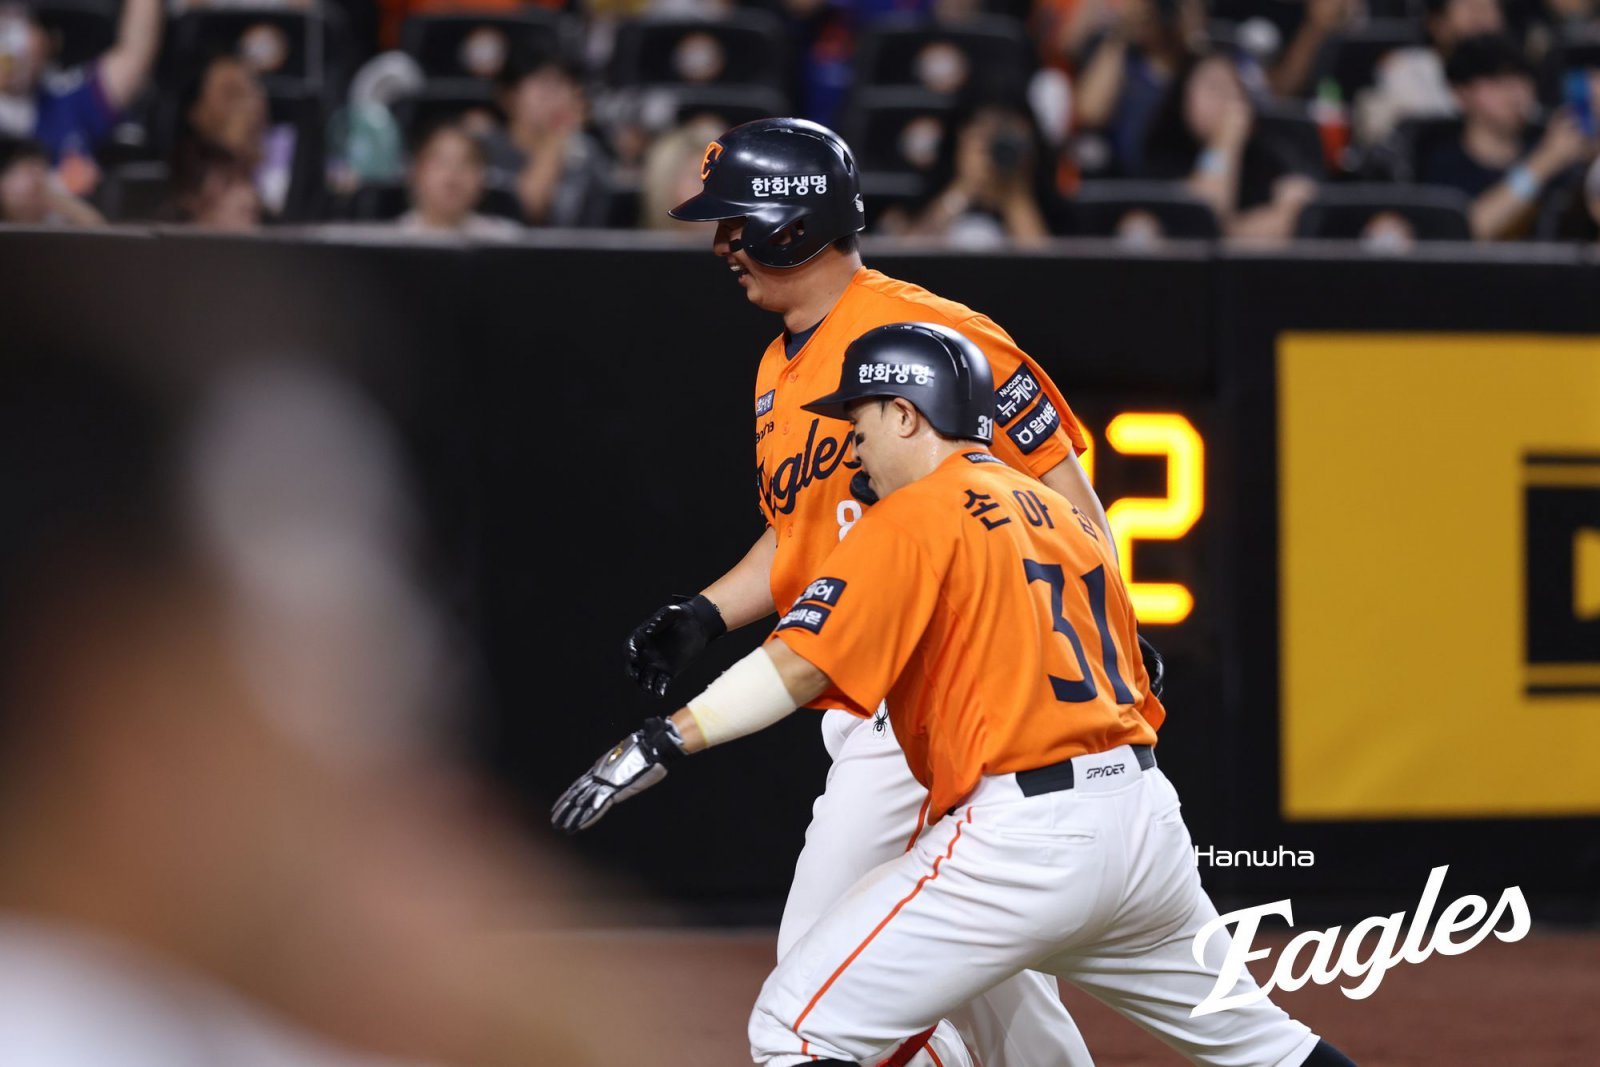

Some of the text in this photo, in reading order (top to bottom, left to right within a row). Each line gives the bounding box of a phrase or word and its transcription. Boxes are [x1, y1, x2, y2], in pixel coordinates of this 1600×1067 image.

[751, 174, 828, 197] 한화생명
[858, 363, 931, 385] 한화생명
[996, 374, 1038, 418] 뉴케어
[977, 415, 993, 439] 31
[1076, 411, 1205, 625] 2
[1022, 558, 1136, 704] 31
[1086, 763, 1126, 780] SPYDER
